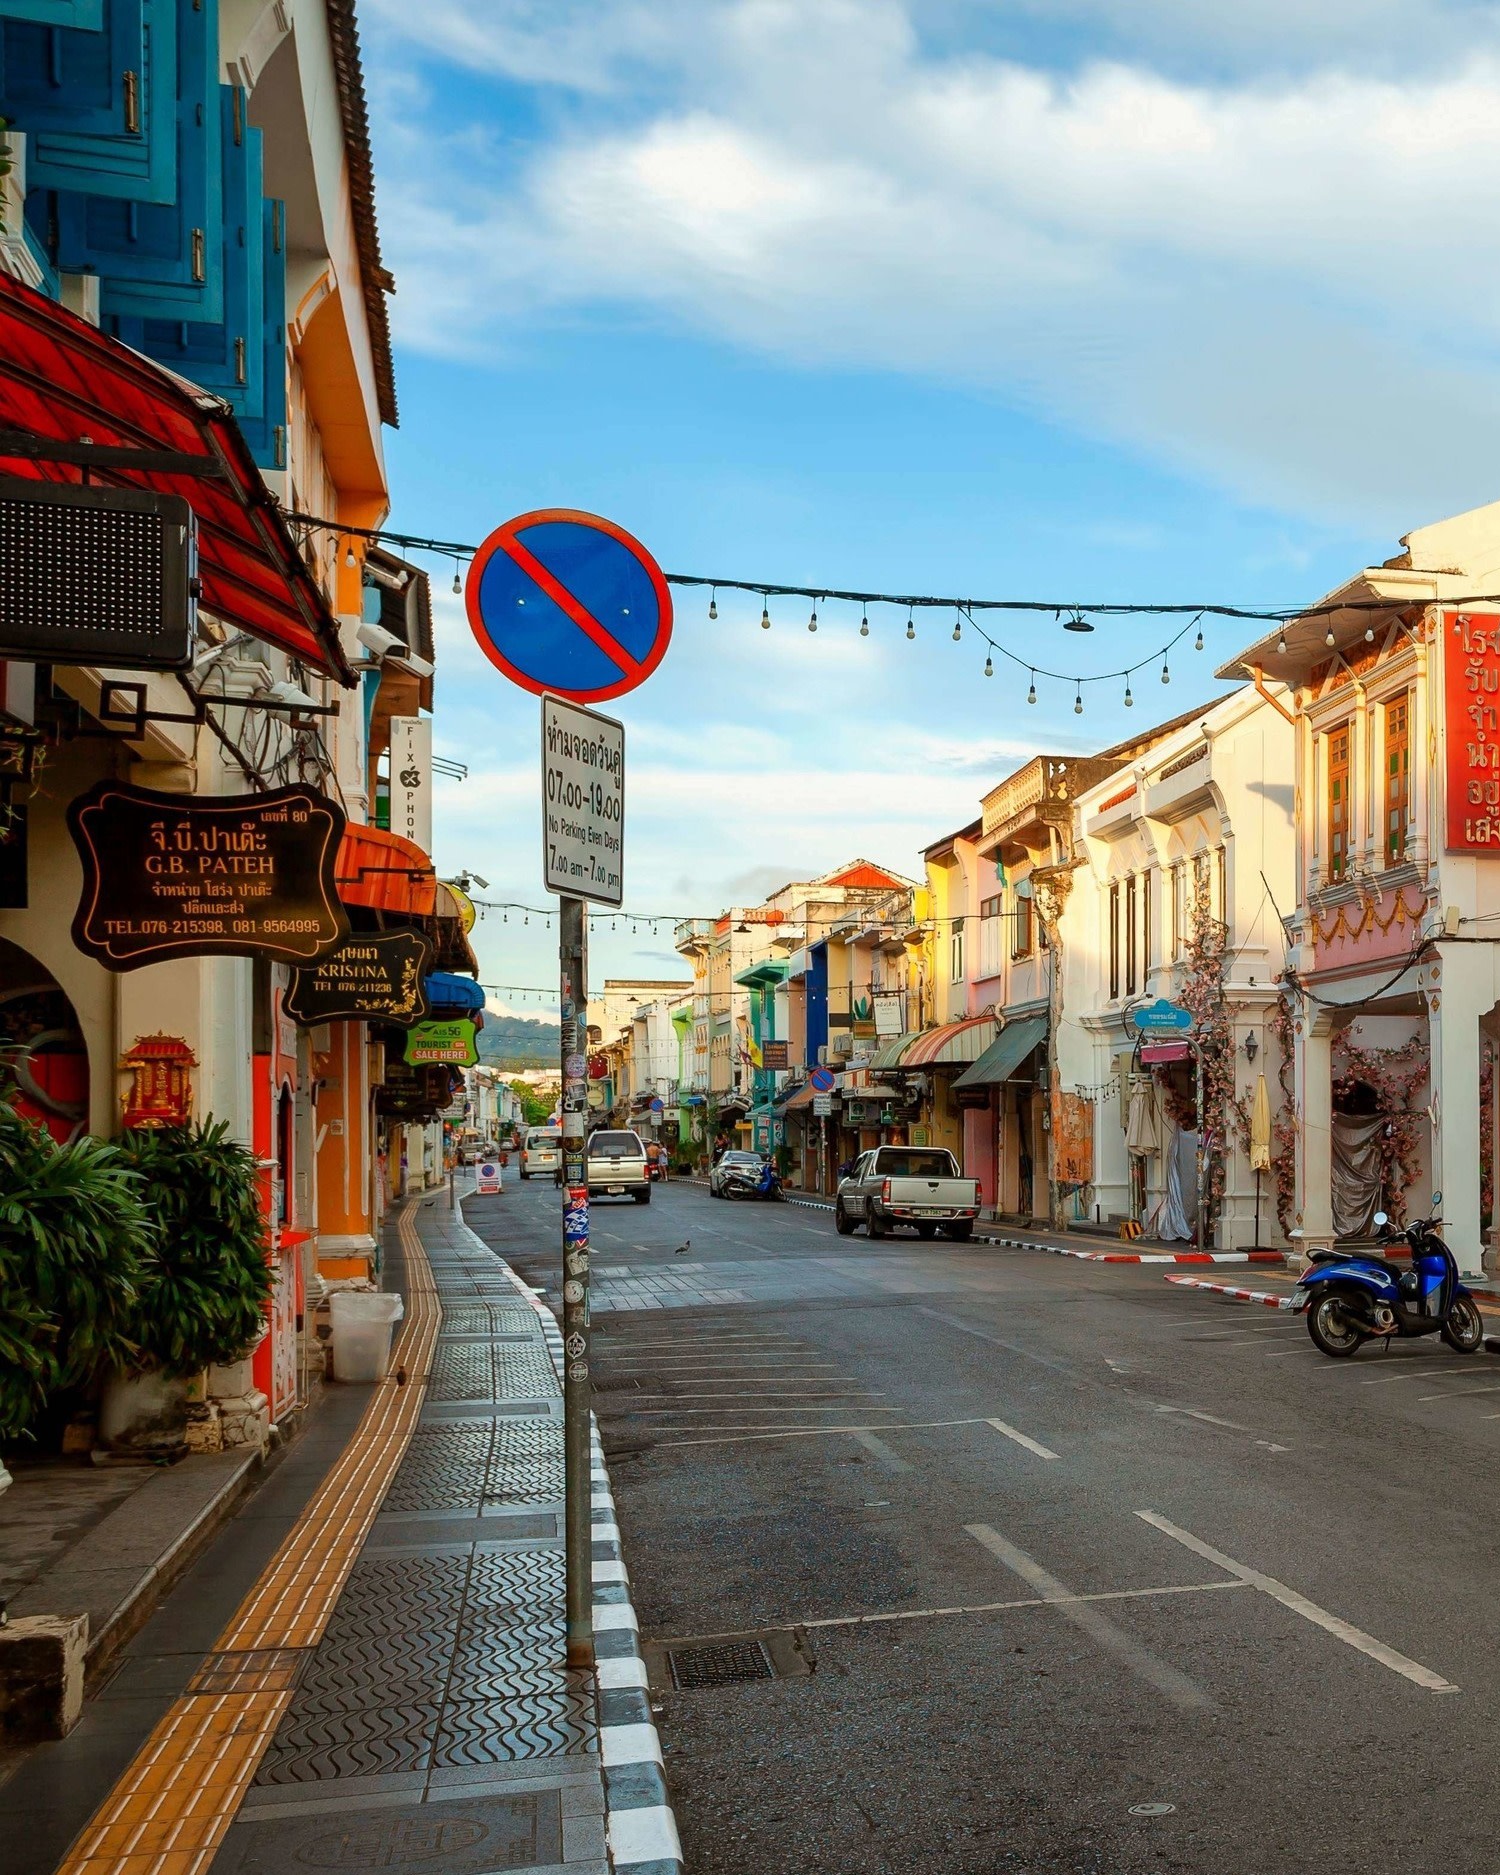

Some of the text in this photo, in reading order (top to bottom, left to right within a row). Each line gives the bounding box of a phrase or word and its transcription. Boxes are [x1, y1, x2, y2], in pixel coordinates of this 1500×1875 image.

[547, 715, 621, 790] ห้ามจอดวันคู่
[547, 768, 621, 823] 07.00-19.00
[260, 806, 308, 823] เลขที่ 80
[406, 791, 415, 839] PHON
[549, 814, 620, 854] No Parking Even Days
[145, 856, 275, 874] G.B. PATEH
[549, 844, 568, 874] 7.00
[607, 871, 620, 889] pm
[233, 919, 320, 933] 081-9564995
[448, 1026, 461, 1036] 5G
[416, 1041, 451, 1049] TOURIST
[415, 1050, 467, 1059] SALE HERE!
